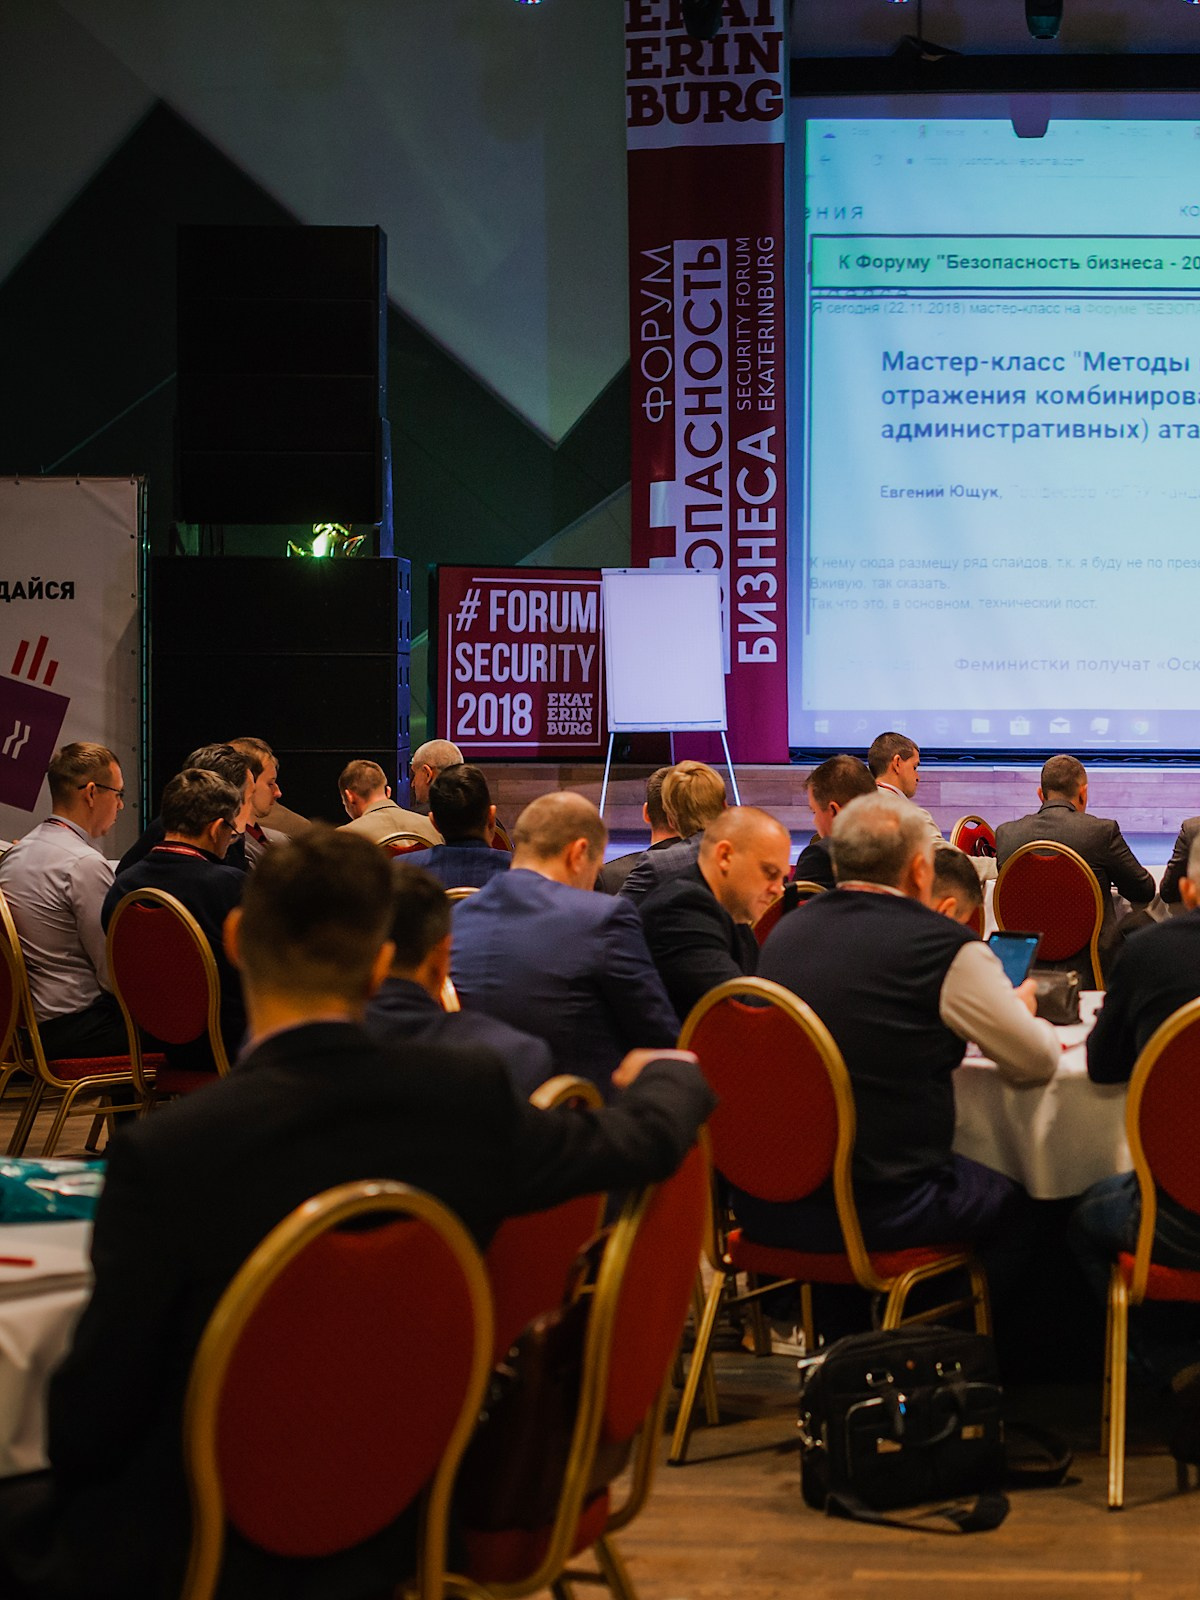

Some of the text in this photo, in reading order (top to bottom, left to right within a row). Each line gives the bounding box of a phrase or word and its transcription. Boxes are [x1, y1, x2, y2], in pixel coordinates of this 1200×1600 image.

[625, 0, 775, 32] EAT
[626, 32, 783, 80] ERIN
[626, 79, 784, 128] BURG
[838, 255, 850, 270] К
[855, 254, 930, 273] Форуму
[937, 254, 1080, 270] "Безопасность
[1086, 254, 1164, 270] бизнеса
[826, 303, 880, 316] сегодня
[883, 301, 967, 316] (22.11.2018)
[969, 303, 1060, 316] мастер-класс
[1065, 304, 1081, 314] на
[640, 244, 673, 423] ФОРУМ
[735, 237, 752, 411] SECURITY FORUM
[757, 236, 775, 411] EKATERINBURG
[881, 350, 1066, 377] Мастер-класс
[1073, 350, 1190, 374] "Методы
[881, 388, 1026, 410] отражения
[682, 245, 724, 632] ОПАСНОСТЬ
[881, 417, 1150, 444] административных)
[880, 484, 944, 499] Евгений
[736, 425, 778, 664] БИЗНЕСА
[822, 559, 856, 571] нему
[859, 559, 895, 571] сюда
[899, 559, 959, 572] размещу
[963, 559, 988, 571] ряд
[1091, 556, 1123, 572] буду
[1127, 559, 1143, 569] не
[1147, 559, 1164, 569] по
[871, 579, 893, 590] так
[456, 588, 597, 633] # FORUM
[455, 642, 596, 683] SECURITY
[953, 656, 1070, 672] Феминистки
[1076, 658, 1151, 673] получат
[547, 692, 593, 707] EKAT
[457, 692, 533, 736] 2018
[547, 707, 593, 721] ERIN
[546, 721, 593, 735] BURG
